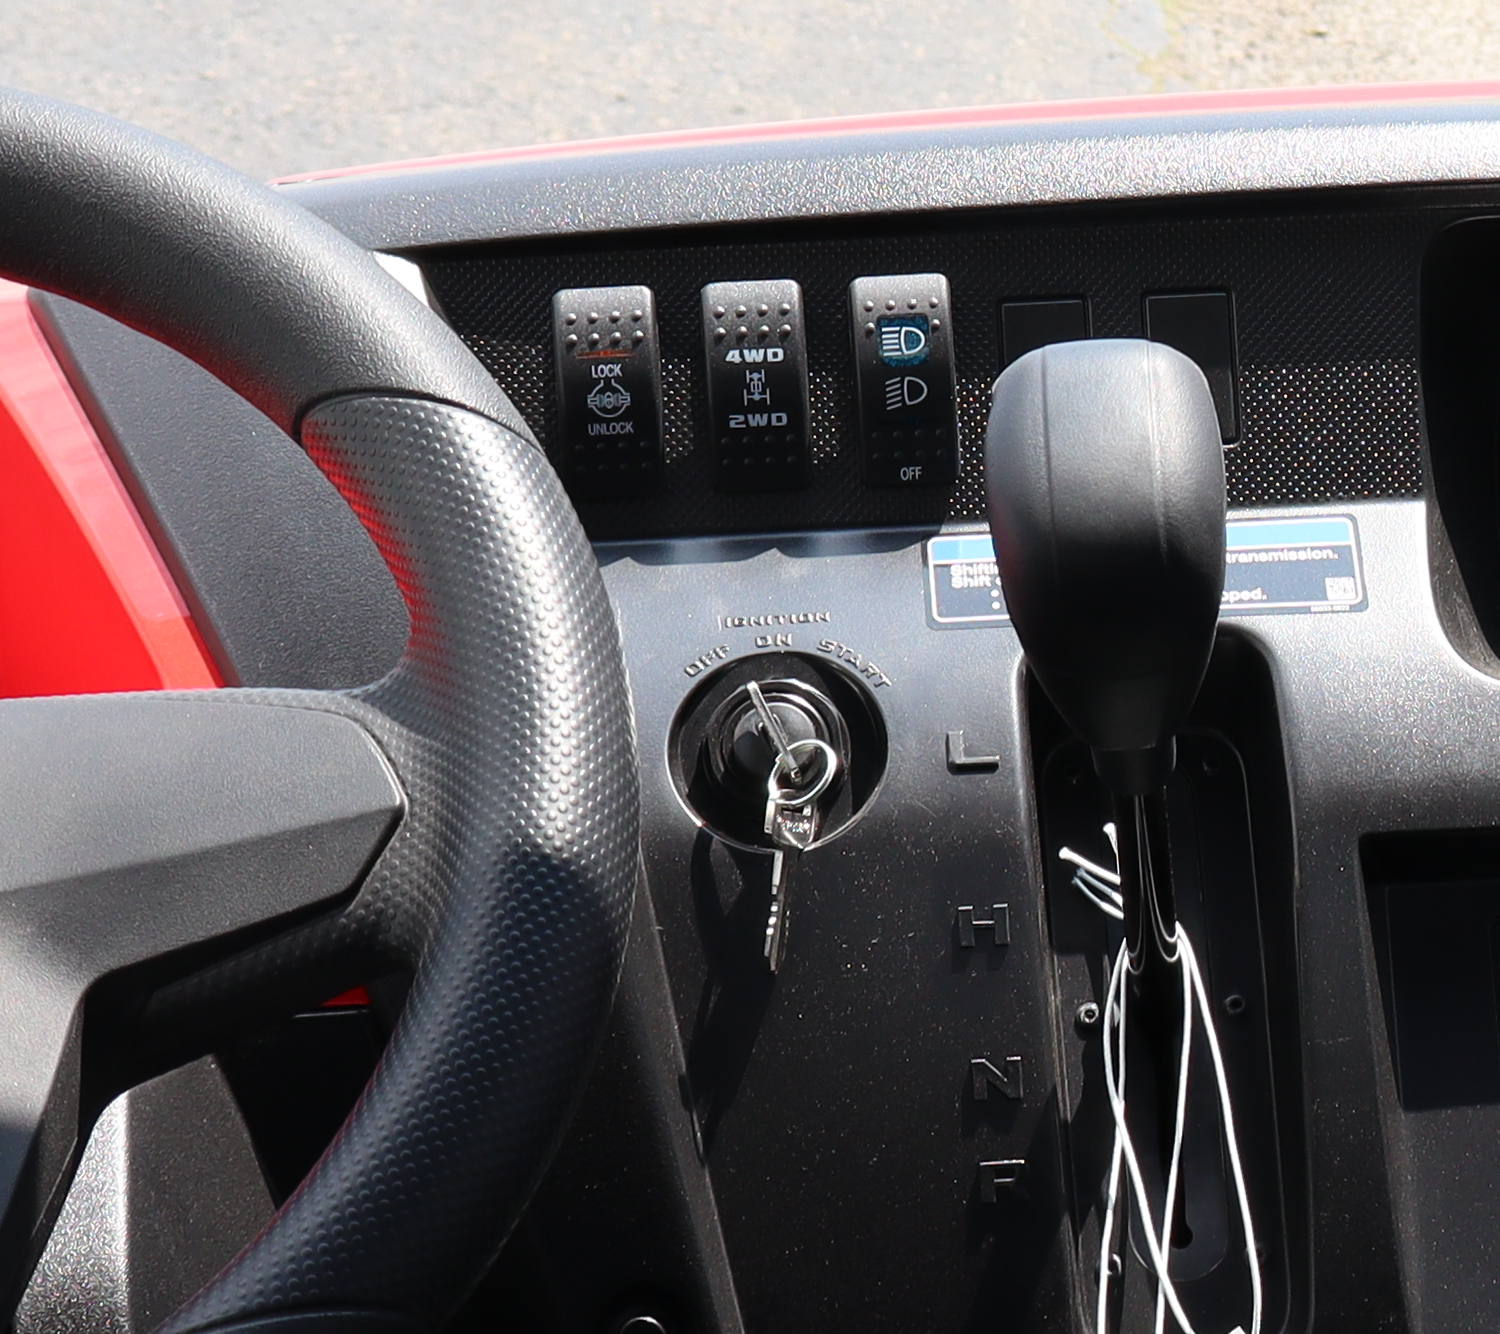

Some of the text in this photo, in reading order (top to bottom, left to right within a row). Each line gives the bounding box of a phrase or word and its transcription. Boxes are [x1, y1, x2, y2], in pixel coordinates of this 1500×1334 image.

[725, 348, 785, 364] 4WD
[591, 362, 623, 380] LOCK
[587, 420, 634, 436] UNLOCK
[728, 412, 788, 428] 2WD
[900, 466, 922, 481] OFF
[1226, 548, 1339, 564] transmission.
[951, 575, 992, 588] Shift
[724, 611, 831, 629] IGNITION
[684, 633, 892, 689] OFF ON START
[946, 730, 1000, 774] L
[958, 903, 1010, 948] H
[970, 1055, 1023, 1100] N
[978, 1158, 1025, 1204] R
